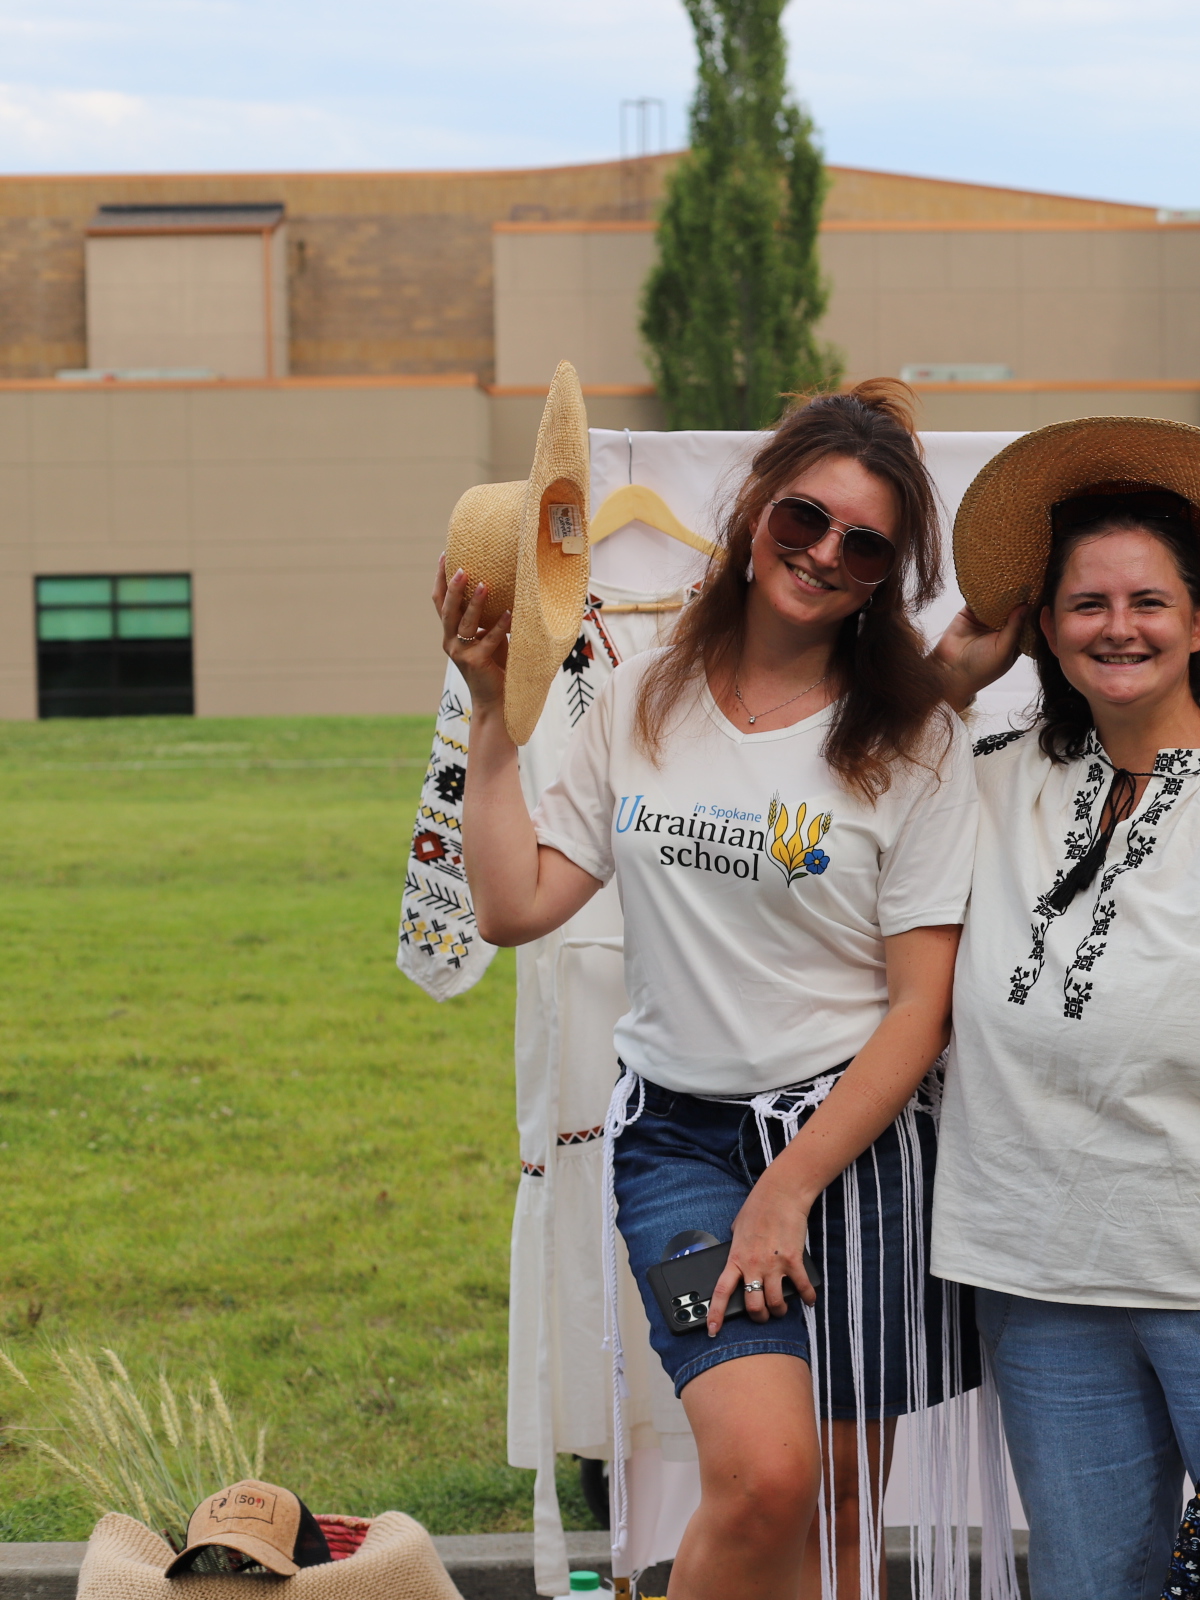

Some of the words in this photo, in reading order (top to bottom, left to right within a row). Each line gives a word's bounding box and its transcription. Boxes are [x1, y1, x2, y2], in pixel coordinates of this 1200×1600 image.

[616, 795, 765, 852] Ukrainian
[694, 802, 706, 814] in
[709, 805, 762, 823] Spokane
[660, 841, 759, 882] school
